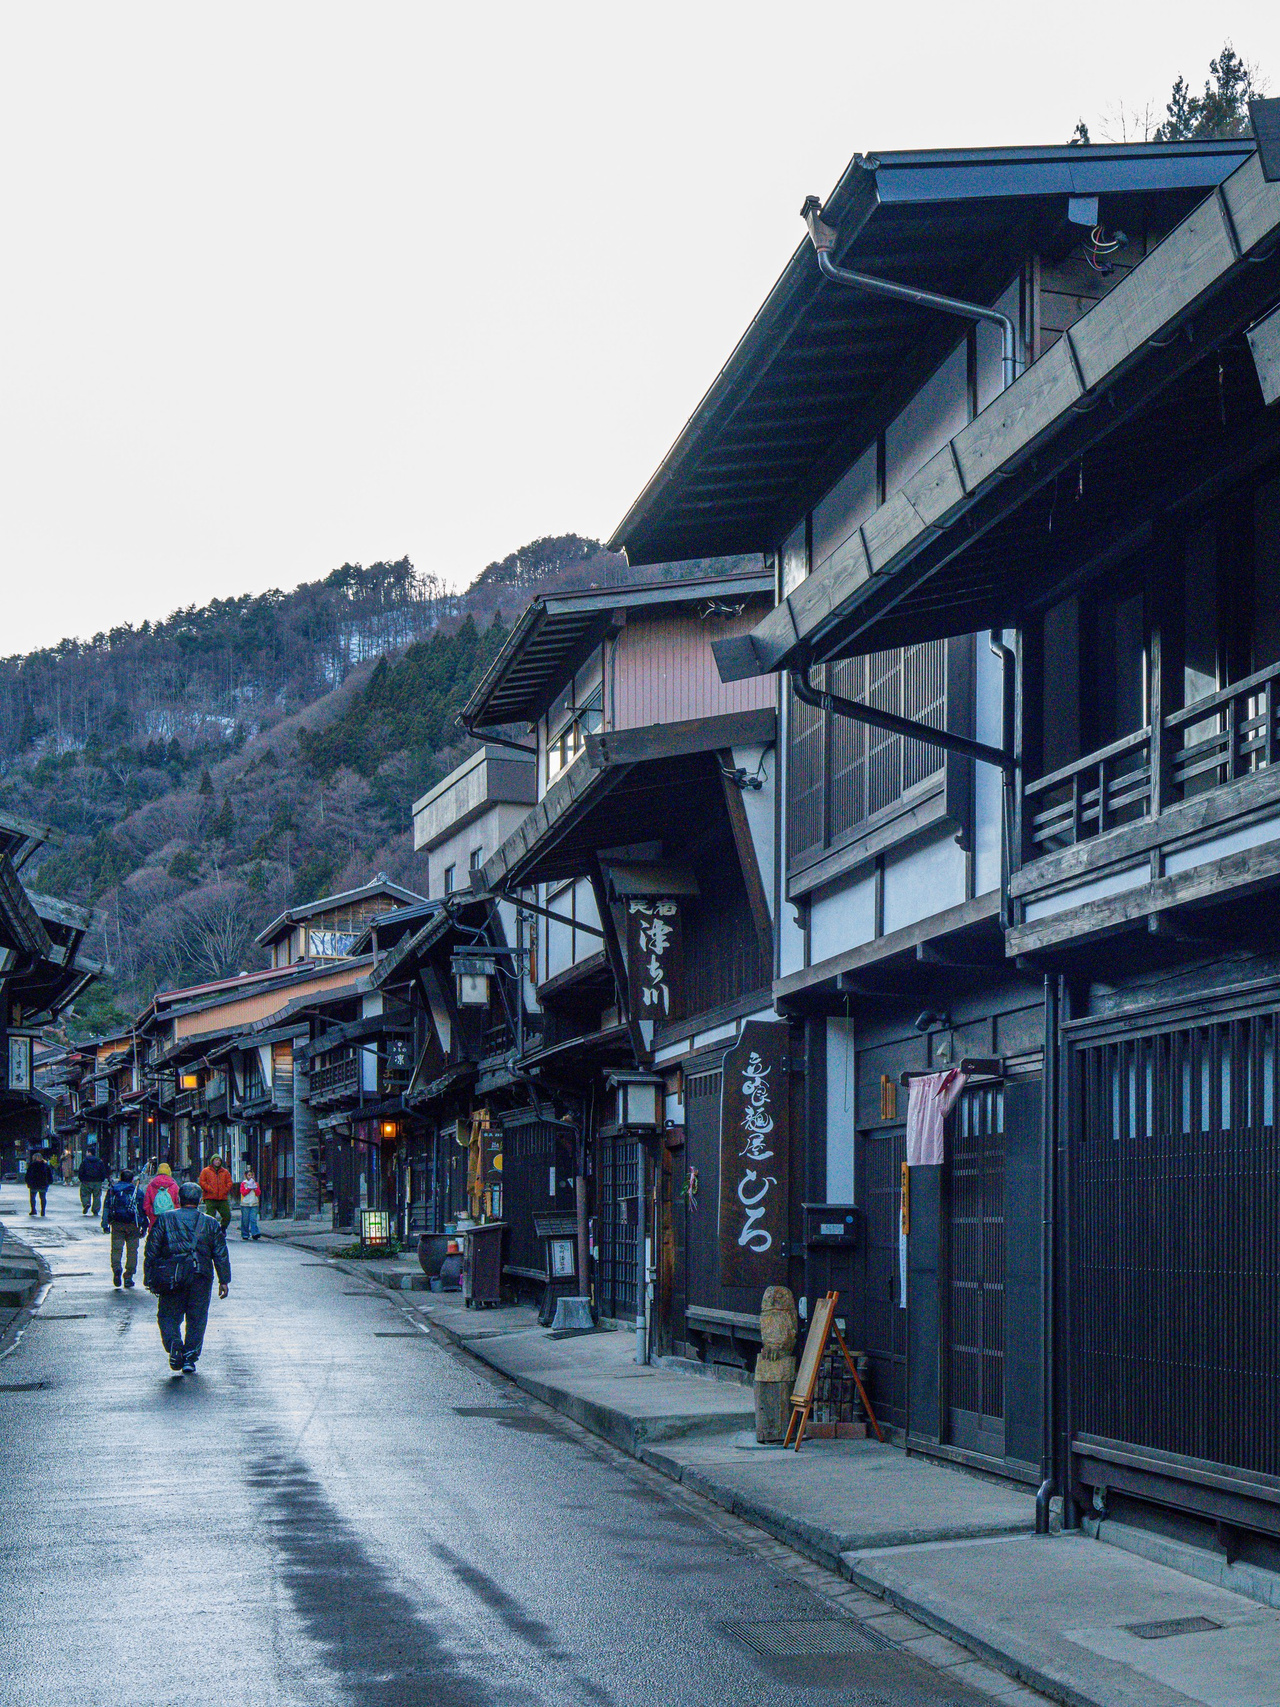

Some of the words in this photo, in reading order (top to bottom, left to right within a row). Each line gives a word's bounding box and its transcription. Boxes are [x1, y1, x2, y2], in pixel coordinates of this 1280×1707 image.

[629, 900, 677, 916] 民宿
[640, 918, 673, 1015] 津ち川
